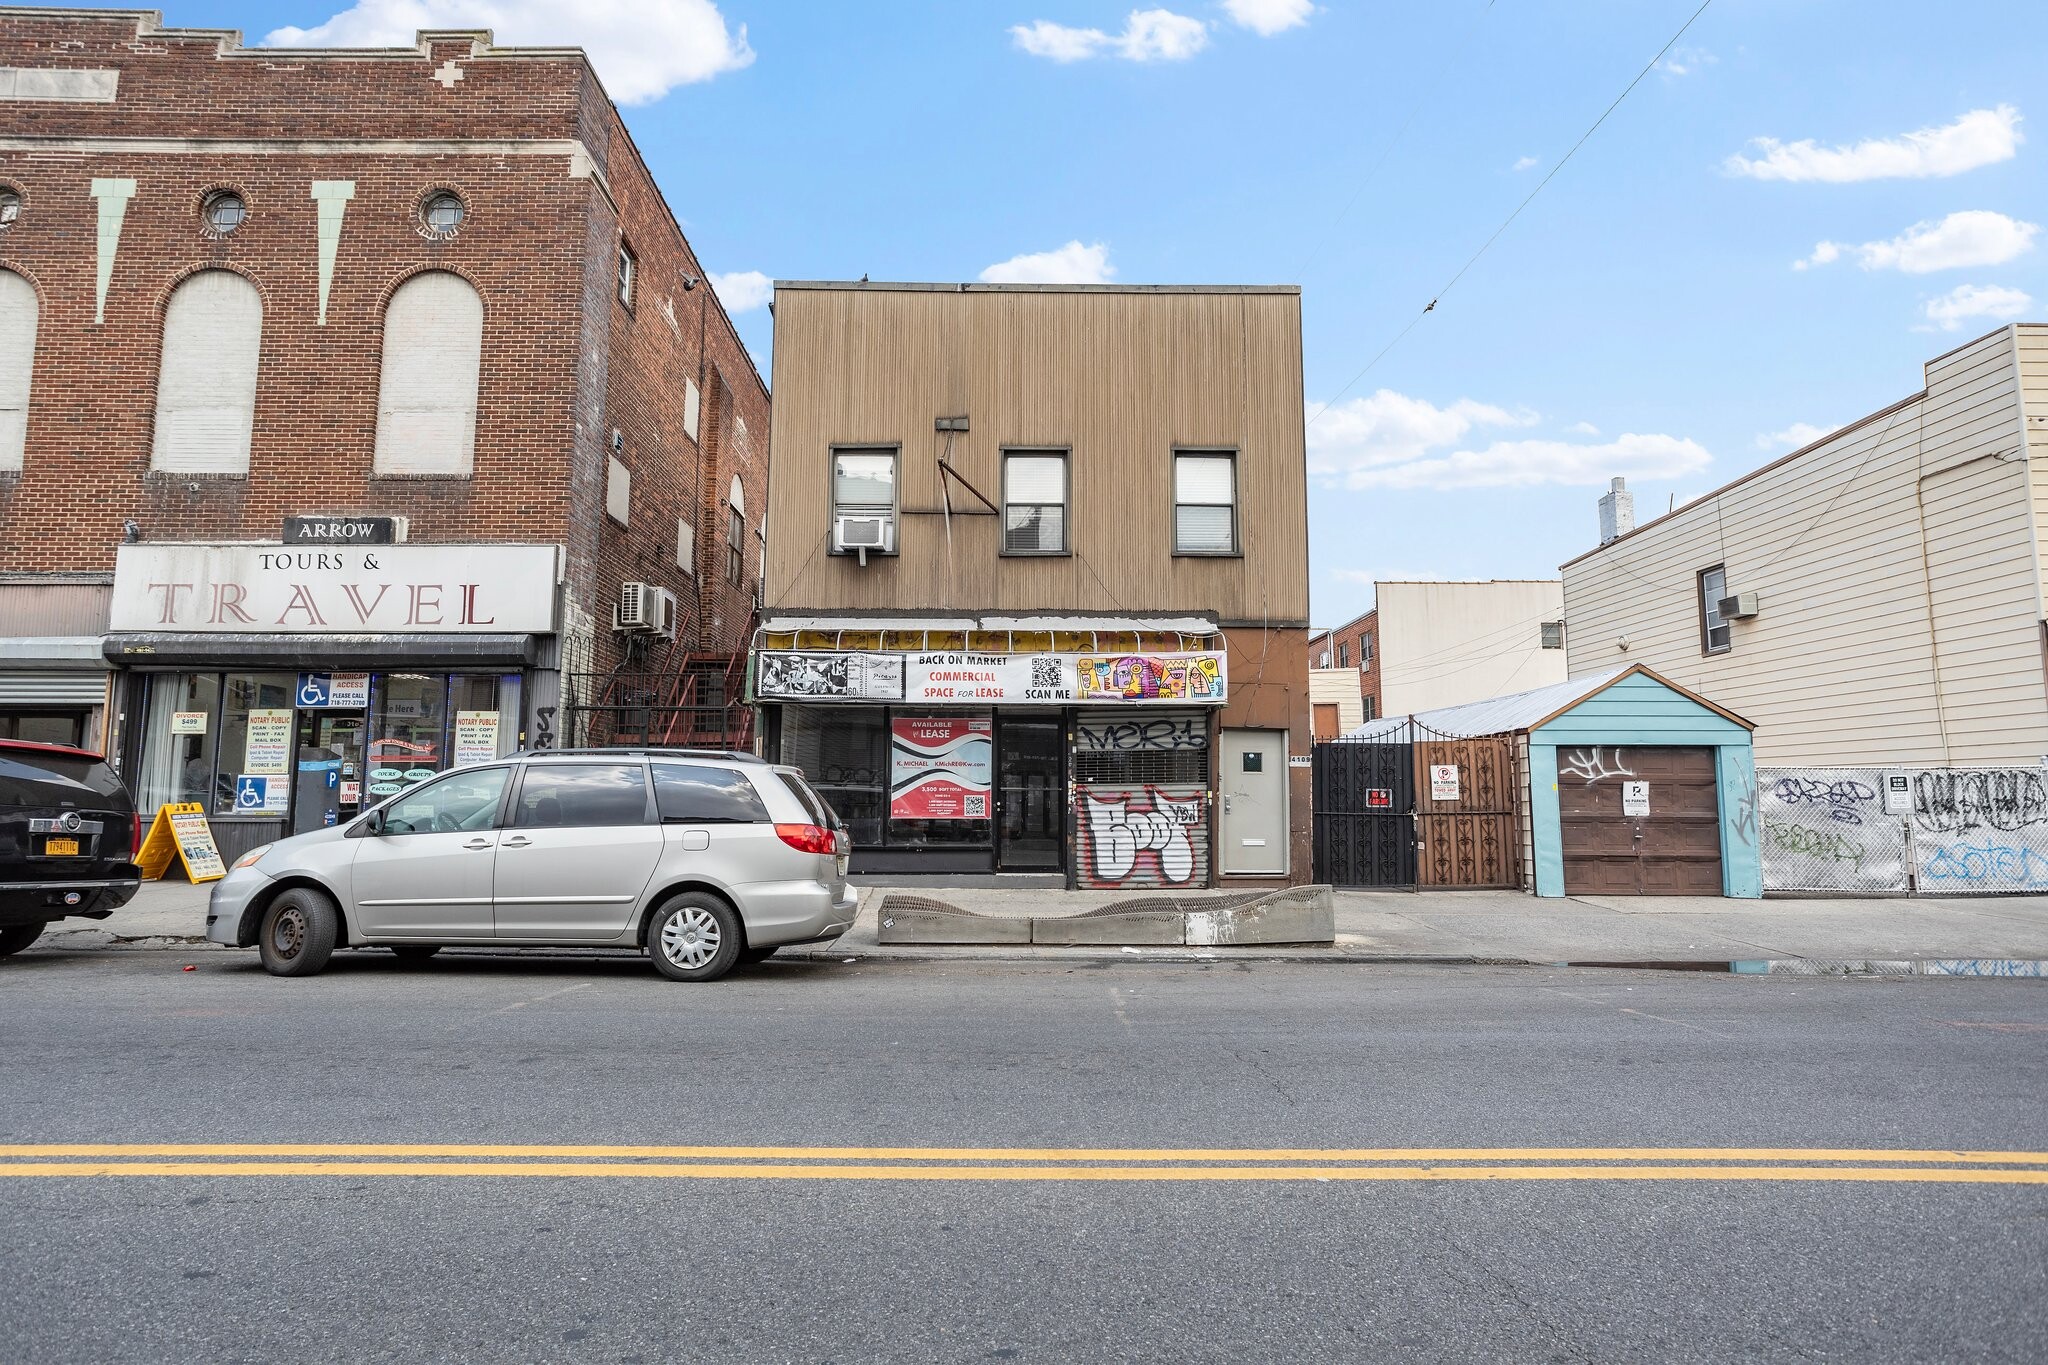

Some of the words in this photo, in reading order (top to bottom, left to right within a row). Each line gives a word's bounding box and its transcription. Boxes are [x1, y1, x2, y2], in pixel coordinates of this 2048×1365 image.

[299, 523, 375, 538] ARROW
[259, 553, 343, 570] TOURS
[363, 553, 380, 570] &
[147, 583, 495, 625] TRAVEL
[919, 655, 945, 665] BACK
[948, 655, 963, 665] ON
[966, 656, 1008, 666] MARKET
[929, 671, 996, 682] COMMERCIAL
[924, 687, 954, 698] SPACE
[957, 690, 974, 698] FOR
[975, 687, 1004, 698] LEASE
[1025, 689, 1051, 699] SCAN
[1055, 690, 1070, 699] ME
[395, 705, 414, 713] Here
[250, 716, 270, 724] NOTARY
[920, 729, 950, 738] LEASE
[329, 771, 337, 787] P
